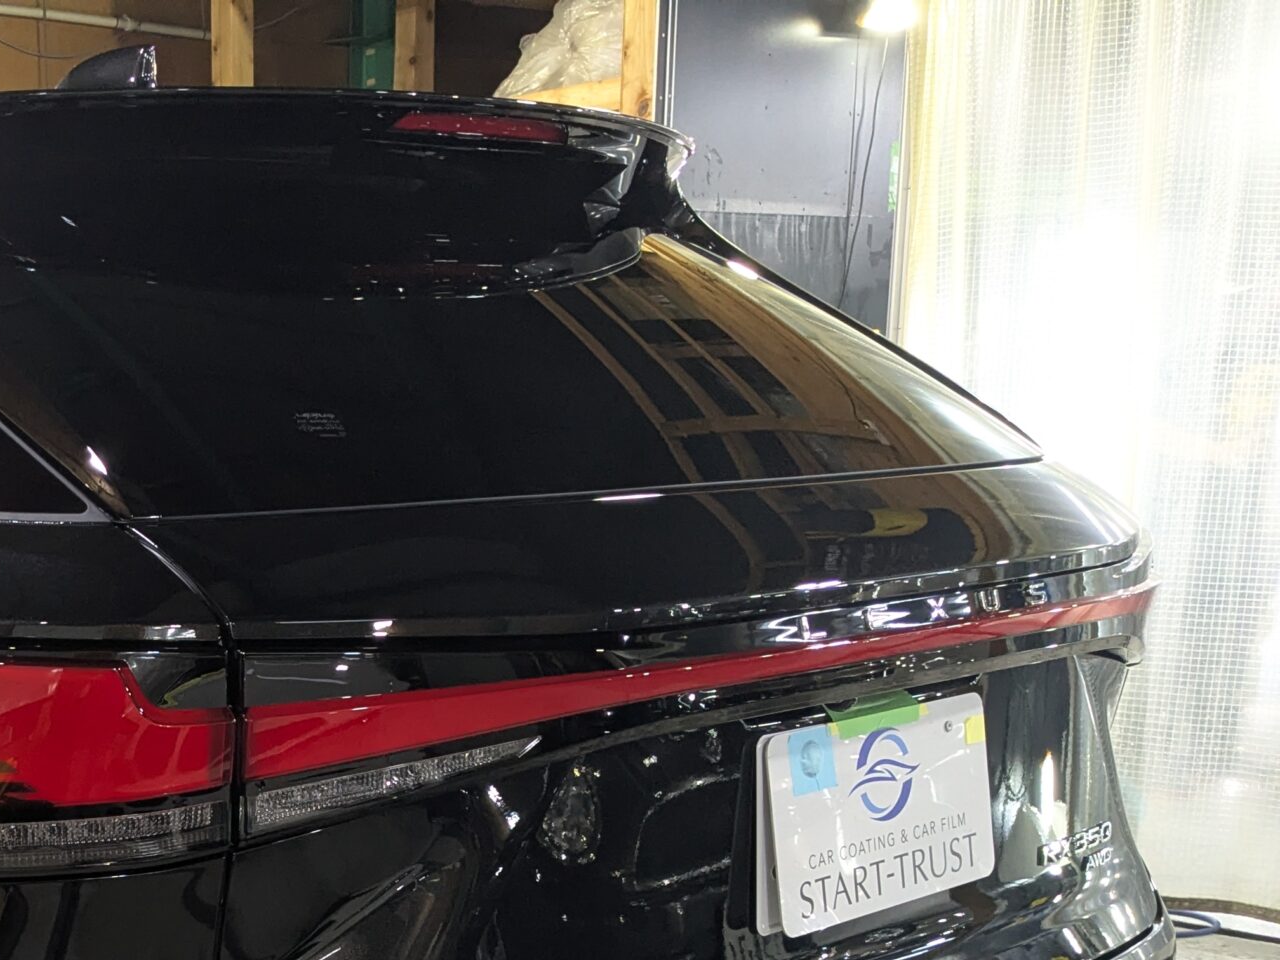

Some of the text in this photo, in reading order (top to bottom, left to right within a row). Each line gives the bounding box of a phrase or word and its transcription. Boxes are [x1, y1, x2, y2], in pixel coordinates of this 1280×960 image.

[799, 832, 978, 920] START-TRUST
[808, 812, 968, 871] CAR COATING & CAR FILM
